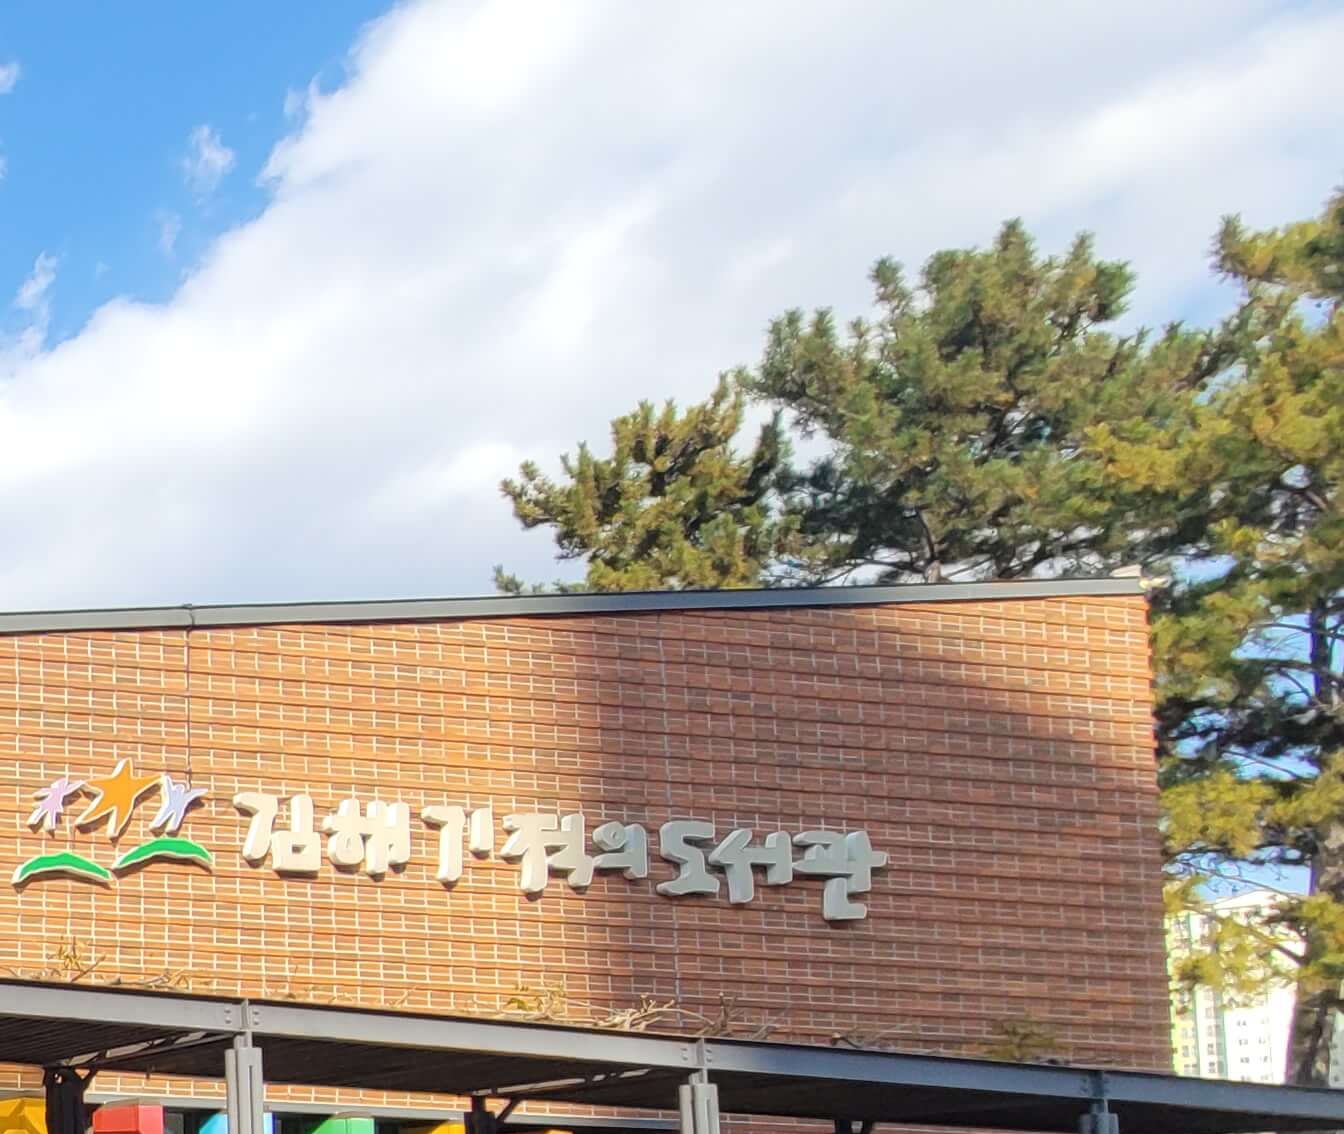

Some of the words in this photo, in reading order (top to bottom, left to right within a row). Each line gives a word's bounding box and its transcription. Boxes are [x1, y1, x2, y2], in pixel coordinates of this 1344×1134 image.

[232, 792, 411, 875] 김해
[420, 805, 648, 895] 기적의
[655, 820, 889, 921] 도서관
